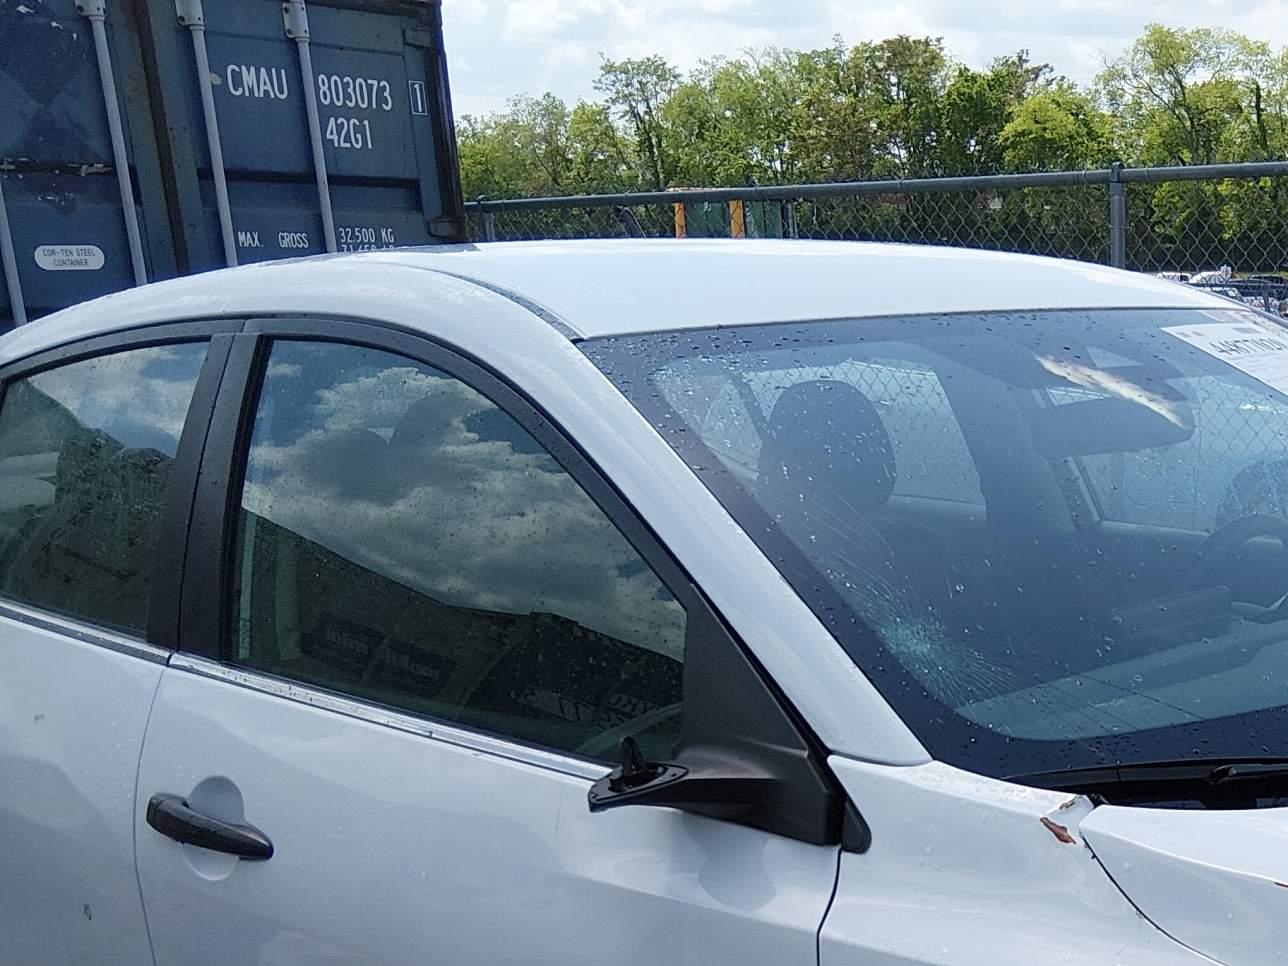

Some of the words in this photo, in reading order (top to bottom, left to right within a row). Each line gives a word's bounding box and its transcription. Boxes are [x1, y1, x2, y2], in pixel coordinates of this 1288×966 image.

[226, 64, 289, 100] CMAU
[317, 73, 393, 111] 803073
[325, 116, 373, 150] 42G1
[237, 231, 265, 248] MAX.
[278, 231, 309, 248] GROSS
[380, 228, 395, 243] KG
[42, 248, 74, 257] COR-TEN
[76, 247, 96, 257] STEEL
[53, 258, 89, 267] CONTAINER
